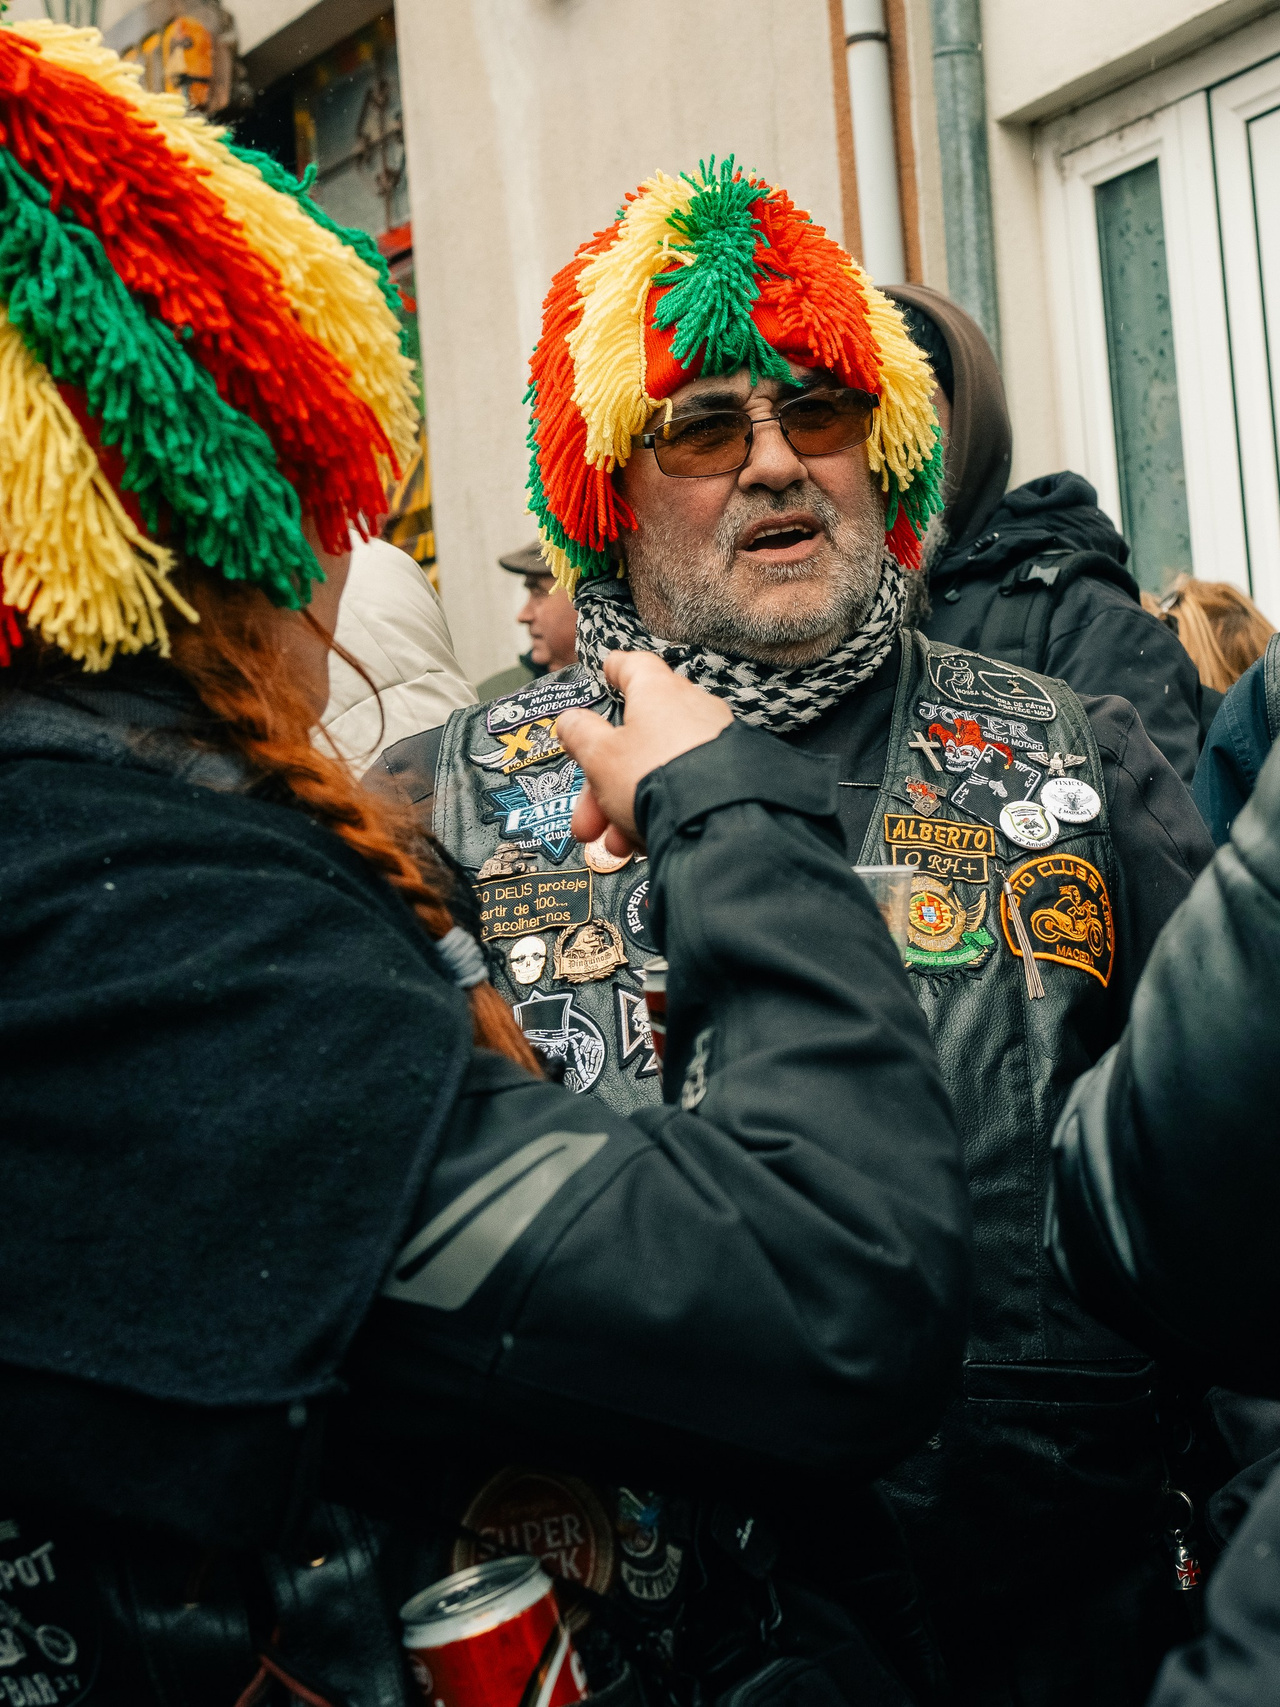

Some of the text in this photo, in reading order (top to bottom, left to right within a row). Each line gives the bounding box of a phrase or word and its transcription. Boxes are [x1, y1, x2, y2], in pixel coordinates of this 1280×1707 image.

[524, 693, 591, 718] ESQUECIDOS
[530, 693, 555, 707] MAS
[919, 701, 1043, 744] JOKER
[982, 731, 1044, 752] GRUPO MOTARD
[892, 819, 988, 849] ALBERTO
[1037, 860, 1099, 893] CLUBE
[495, 883, 533, 900] DEUS
[538, 878, 588, 895] proteje
[480, 904, 508, 920] artir
[513, 903, 530, 916] de
[493, 911, 571, 933] acolher-nos
[1056, 944, 1095, 967] MACEDA
